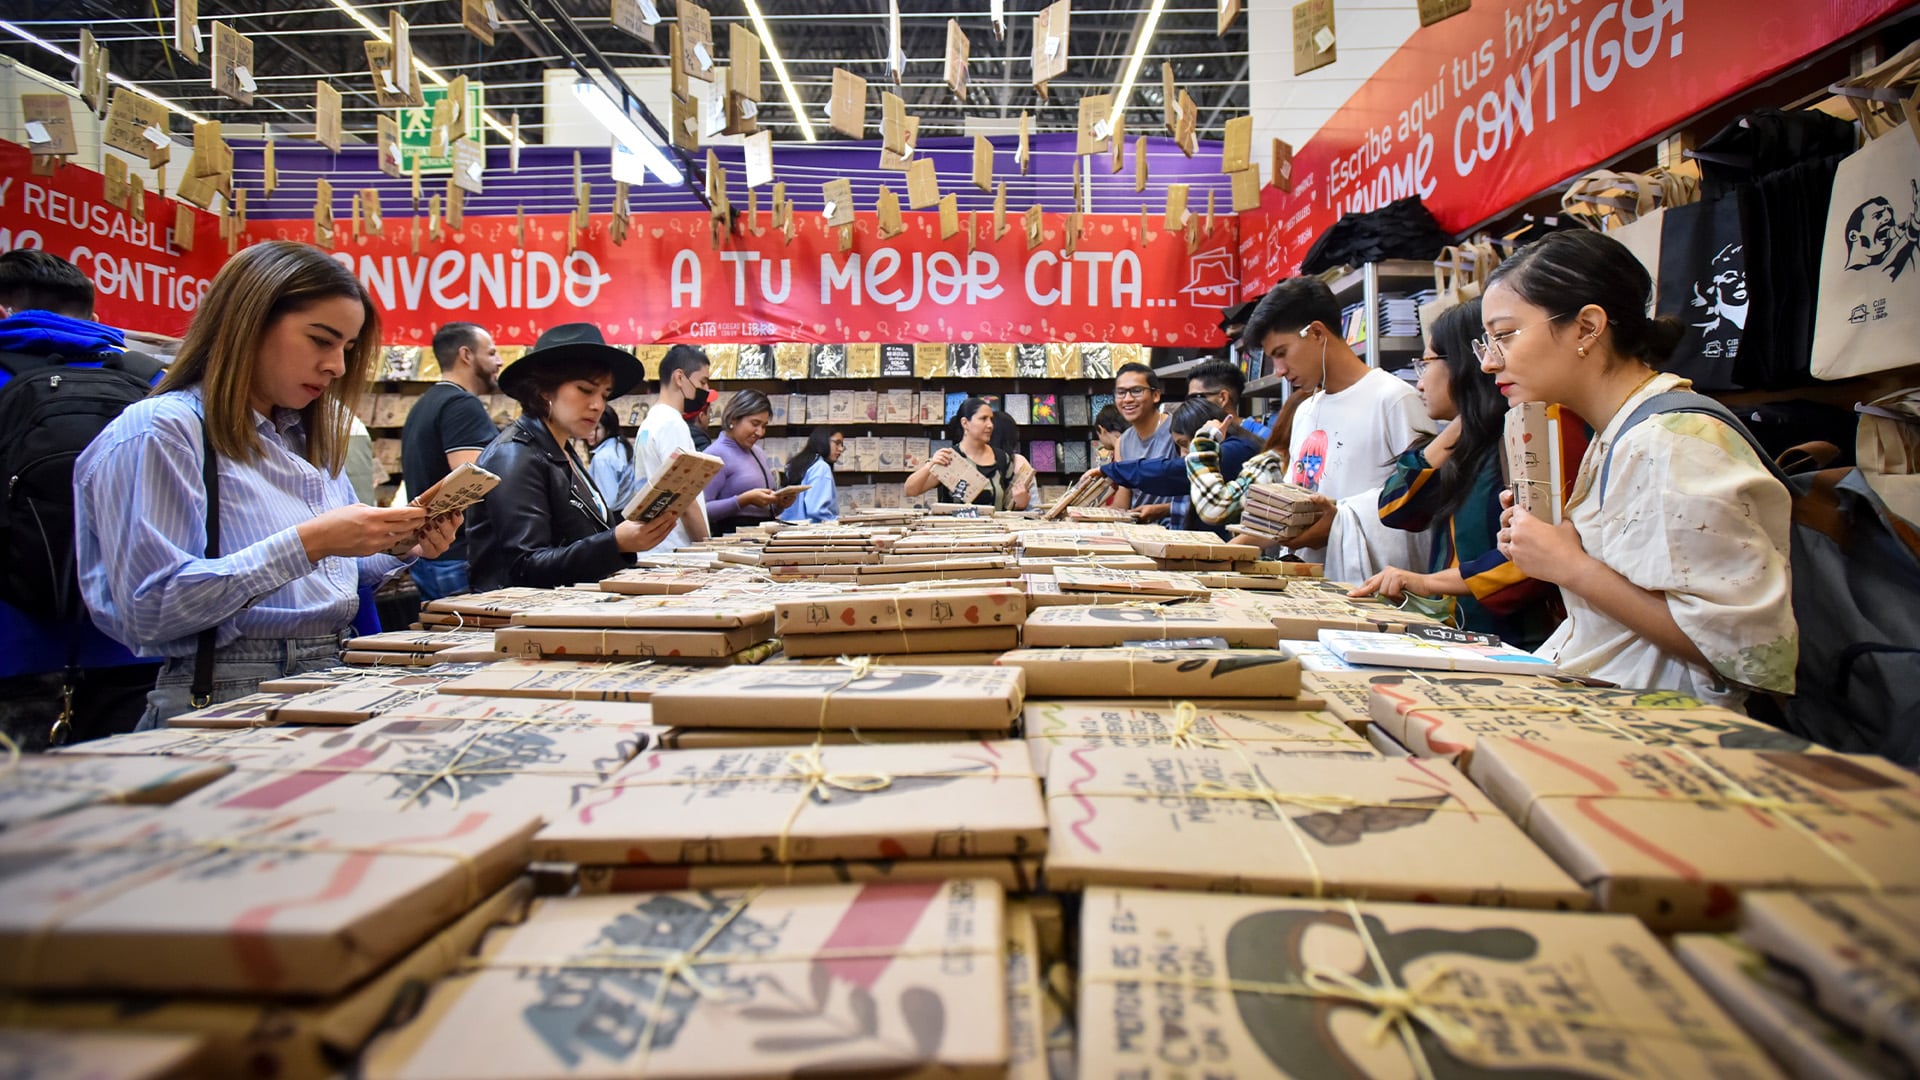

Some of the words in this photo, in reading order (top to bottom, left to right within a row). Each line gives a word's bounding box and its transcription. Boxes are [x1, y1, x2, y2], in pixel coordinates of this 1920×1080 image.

[1326, 125, 1392, 210] ¡Escribe
[1397, 64, 1446, 138] aquí
[1452, 37, 1496, 98] tus
[24, 182, 181, 257] REUSABLE
[671, 249, 701, 308] A
